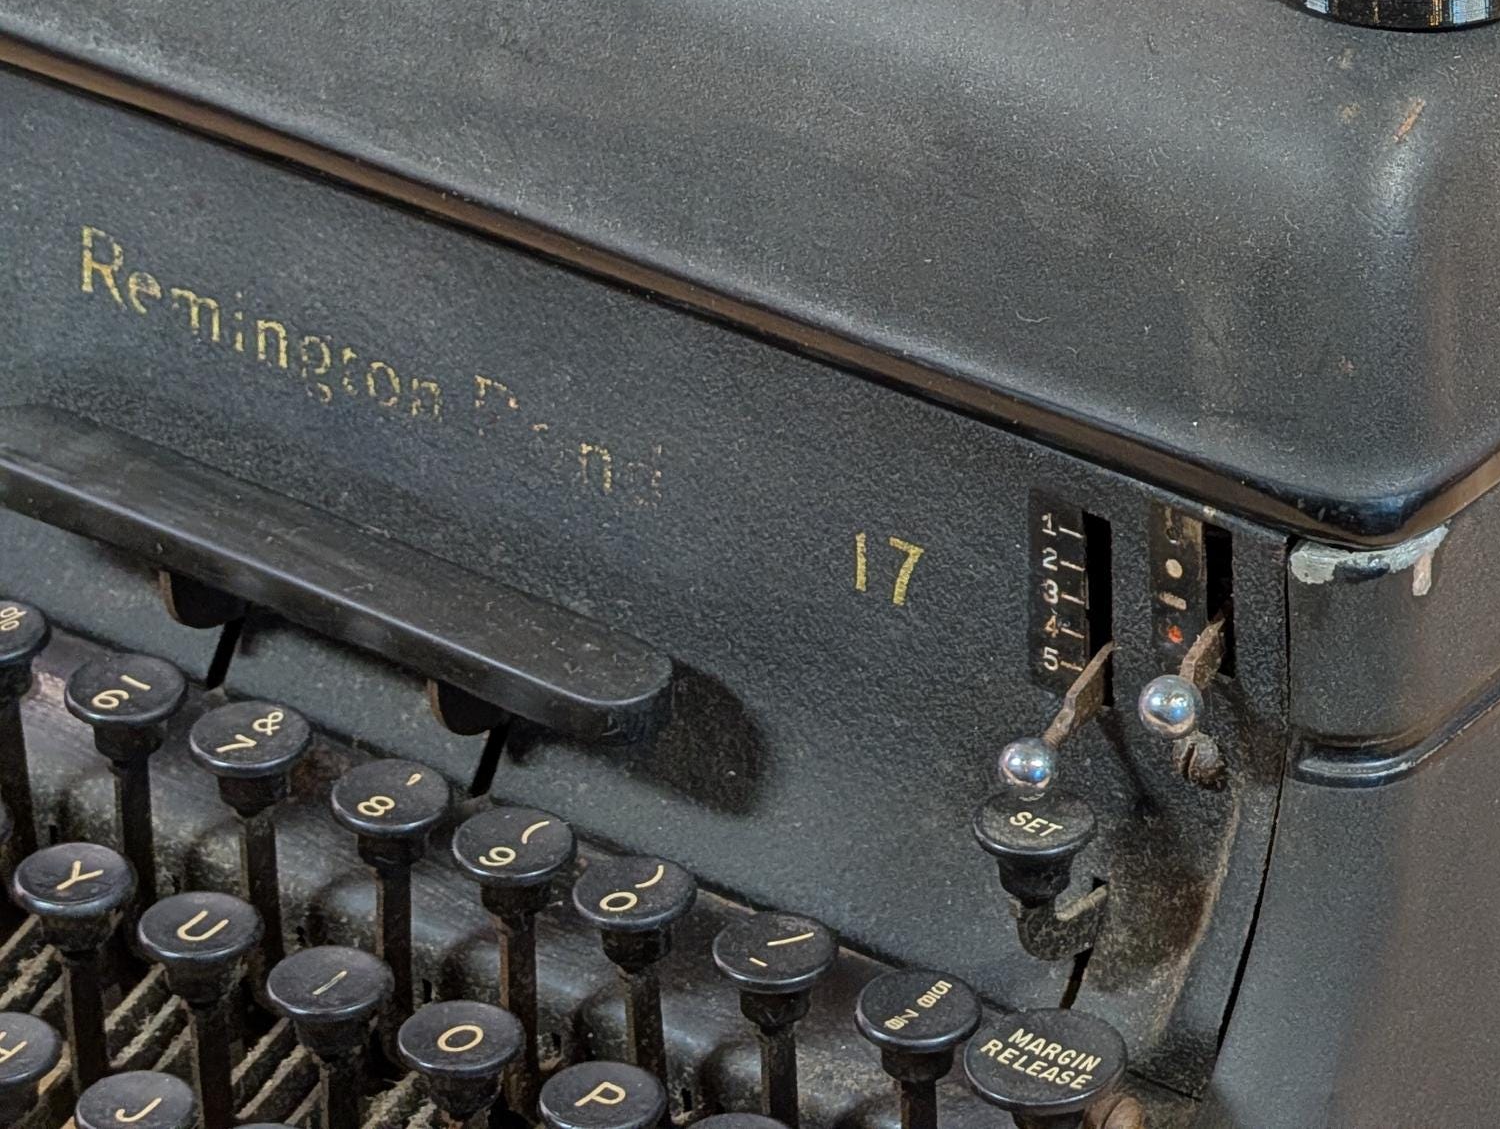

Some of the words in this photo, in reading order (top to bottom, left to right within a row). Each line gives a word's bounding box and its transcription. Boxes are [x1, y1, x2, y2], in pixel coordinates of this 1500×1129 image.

[1042, 513, 1057, 536] 1
[855, 532, 924, 606] 17
[1042, 547, 1058, 571] 2
[1042, 579, 1059, 604] 3
[1044, 615, 1058, 638] 4
[1043, 646, 1059, 671] 5
[91, 689, 129, 709] 6
[252, 710, 284, 736] &
[216, 733, 257, 754] 7
[357, 795, 396, 817] 8
[1009, 810, 1064, 839] SET
[478, 845, 517, 867] 9
[56, 860, 104, 891] Y
[177, 910, 229, 941] U
[1008, 1028, 1102, 1073] MARGIN
[979, 1038, 1093, 1090] RELEASE
[574, 1080, 627, 1107] P
[115, 1097, 163, 1123] J
